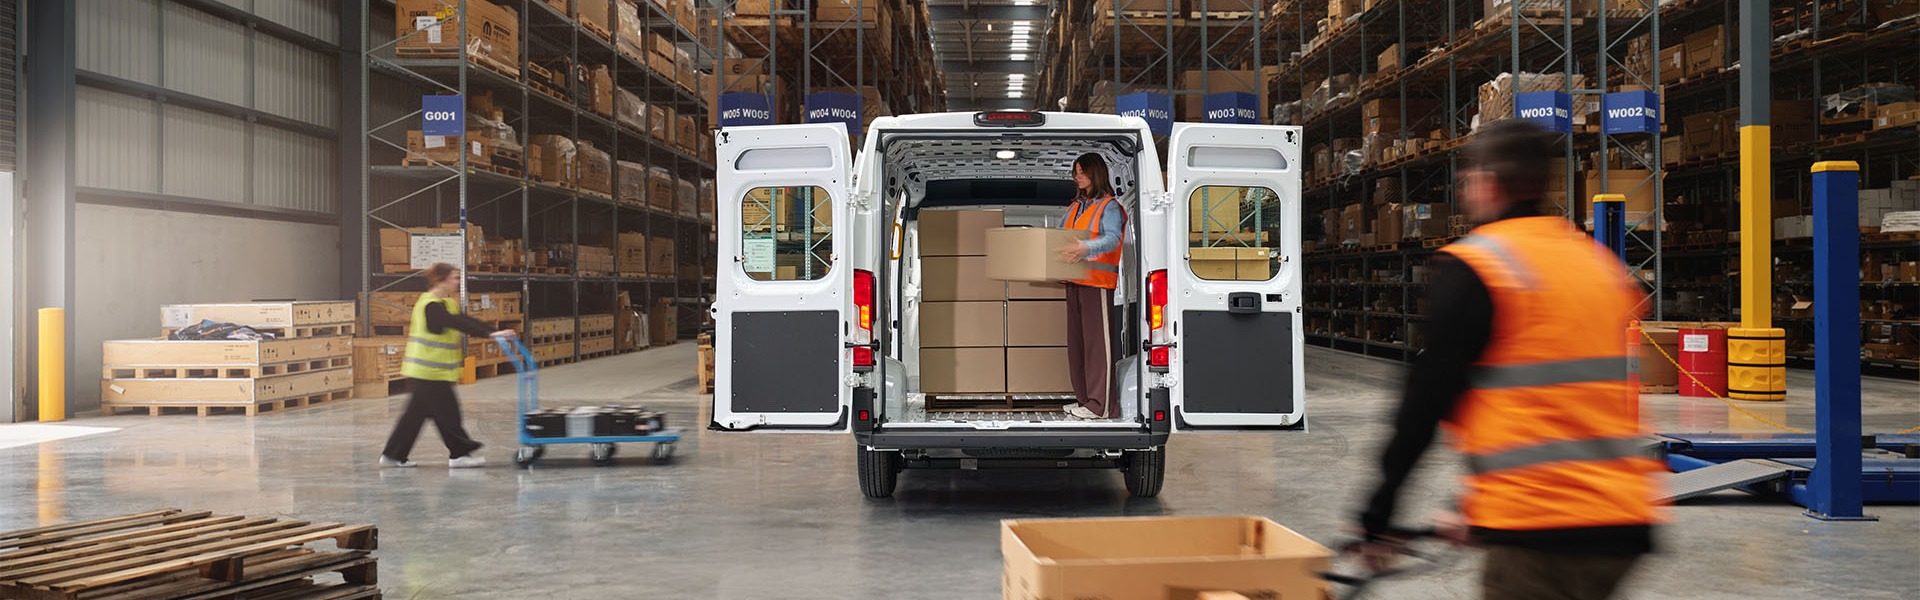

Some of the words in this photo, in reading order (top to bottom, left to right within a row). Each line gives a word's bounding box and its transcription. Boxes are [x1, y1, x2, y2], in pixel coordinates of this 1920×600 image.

[425, 111, 456, 121] G001
[723, 108, 741, 119] W005
[742, 108, 769, 120] W005
[809, 108, 829, 119] W004
[831, 108, 857, 119] W004
[1148, 108, 1168, 120] W004
[1208, 108, 1235, 119] W003
[1237, 108, 1256, 119] W003
[1520, 107, 1554, 119] W003
[1608, 107, 1643, 119] W002
